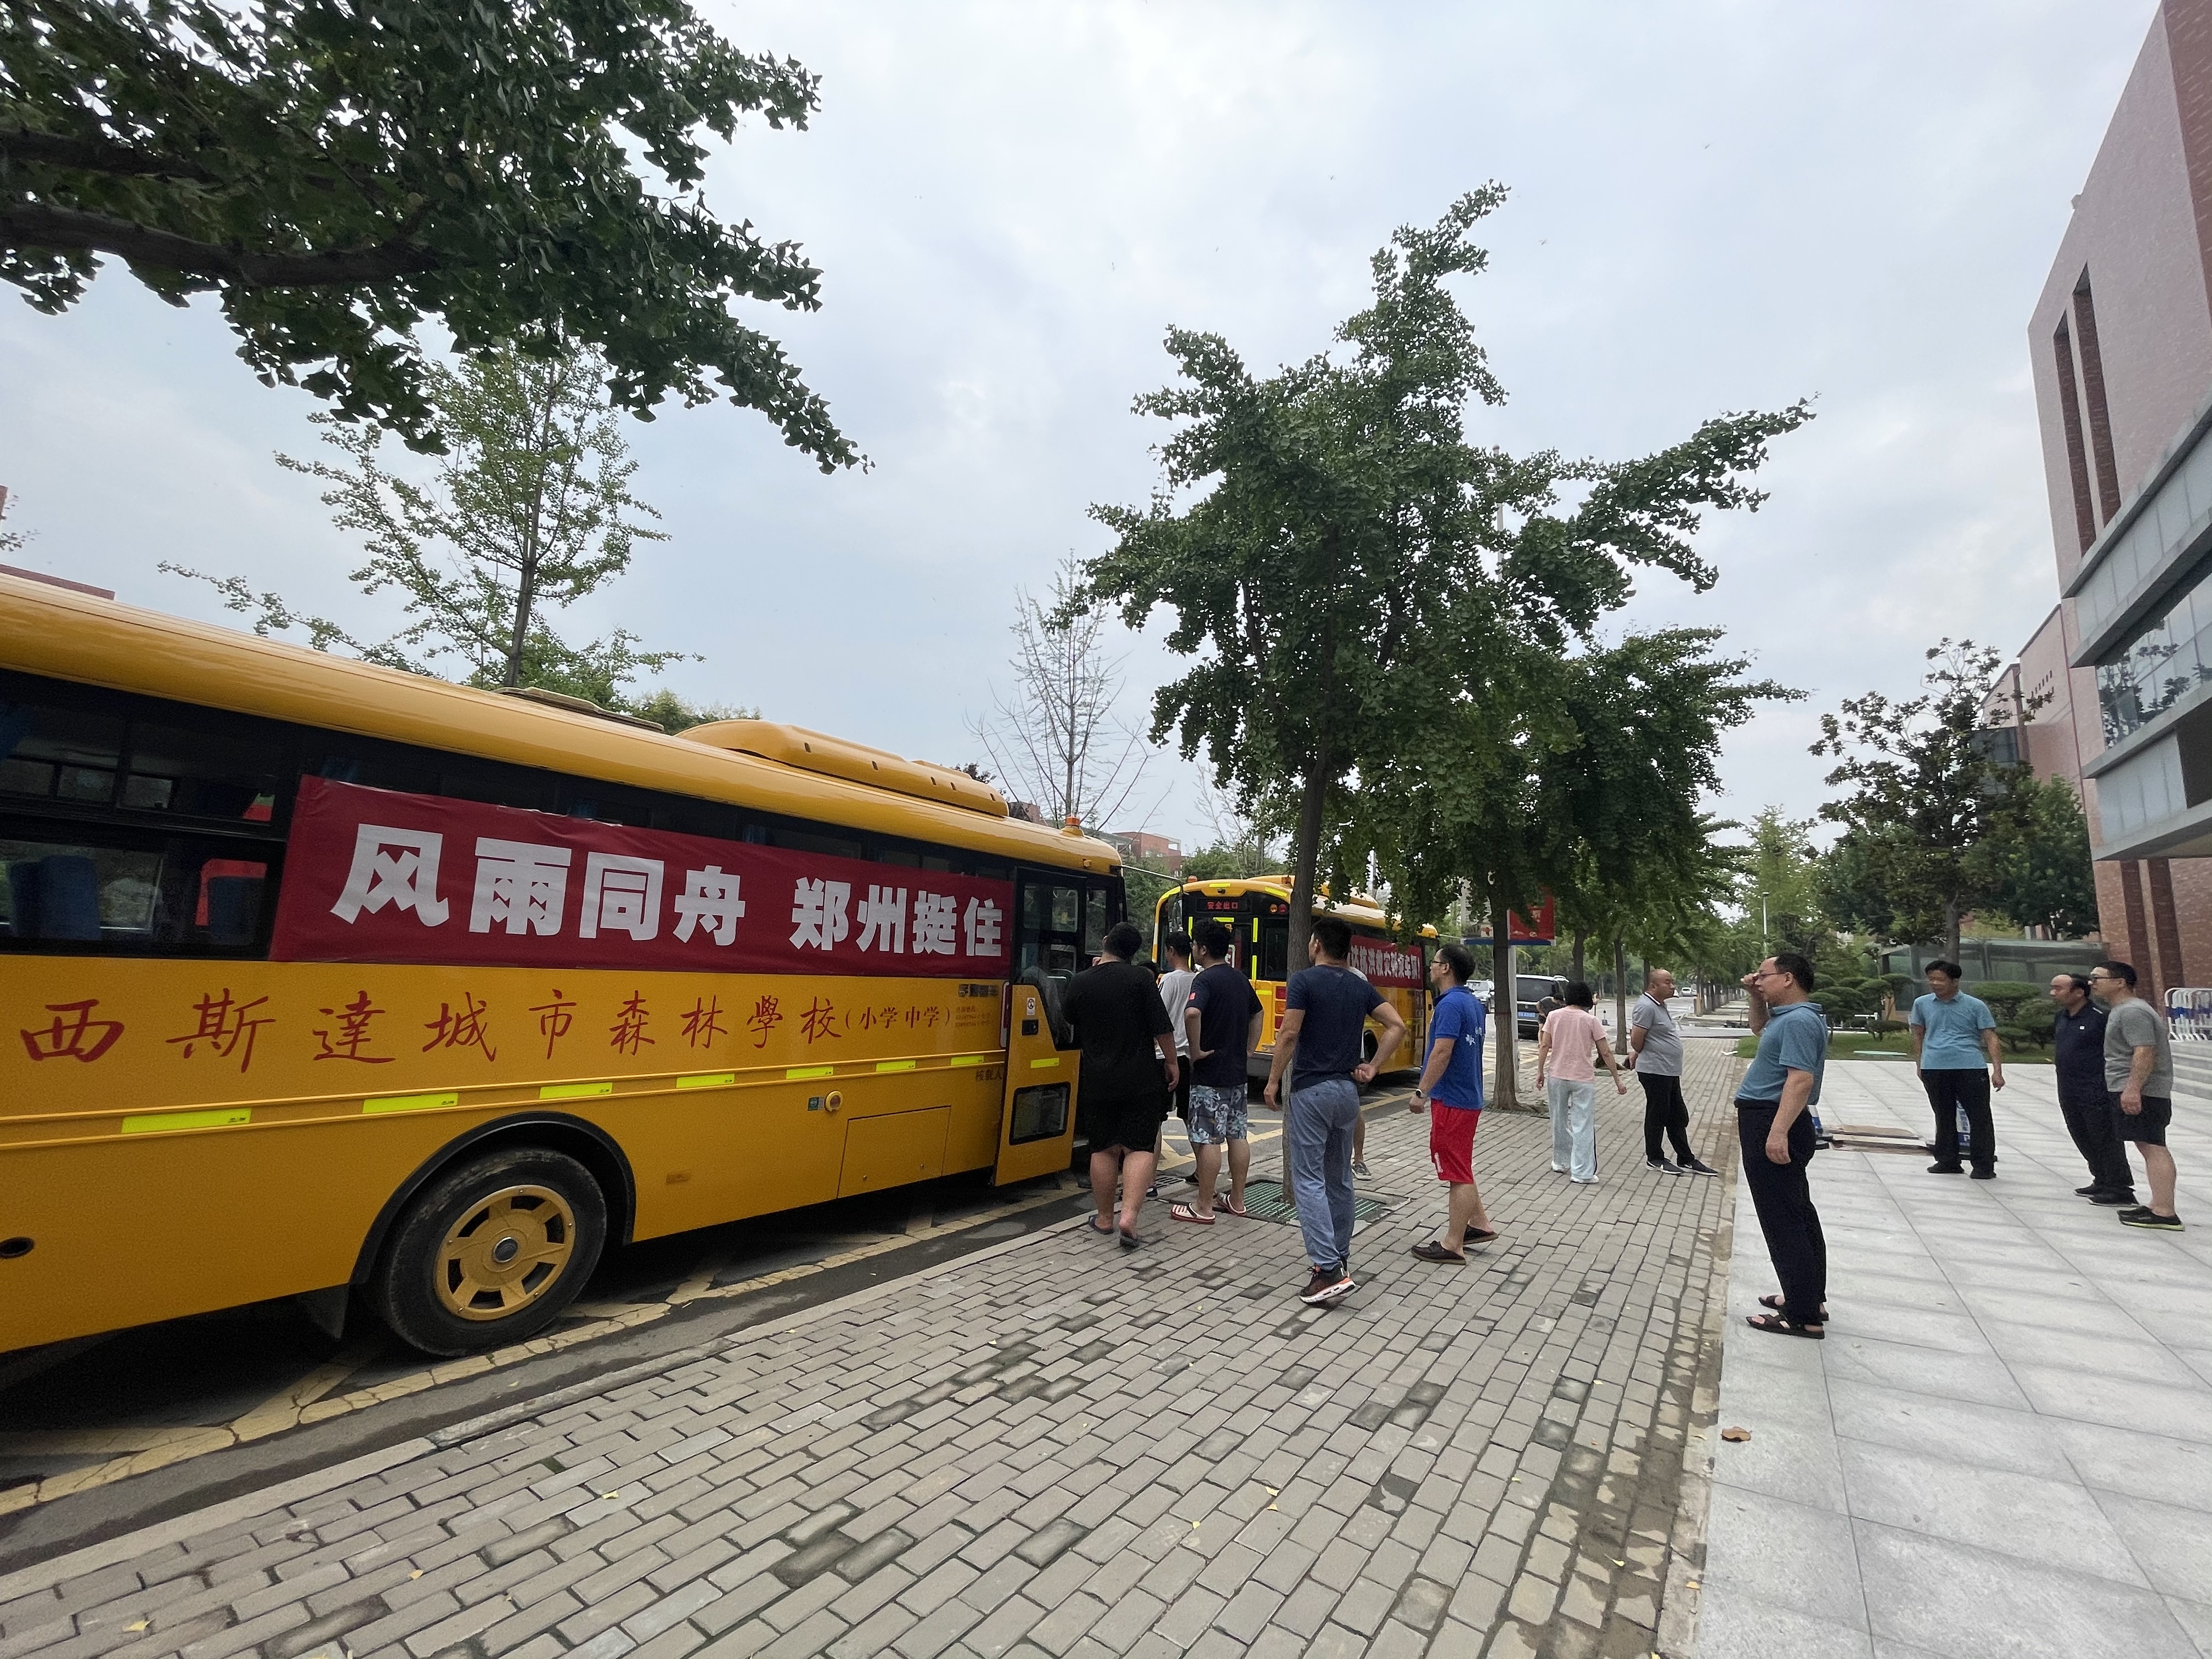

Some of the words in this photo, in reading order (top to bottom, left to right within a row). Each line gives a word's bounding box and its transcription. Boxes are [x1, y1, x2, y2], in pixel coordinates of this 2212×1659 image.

[330, 823, 746, 946] 风雨同舟
[789, 876, 1002, 957] 郑州挺住
[1207, 901, 1238, 910] 安全出口
